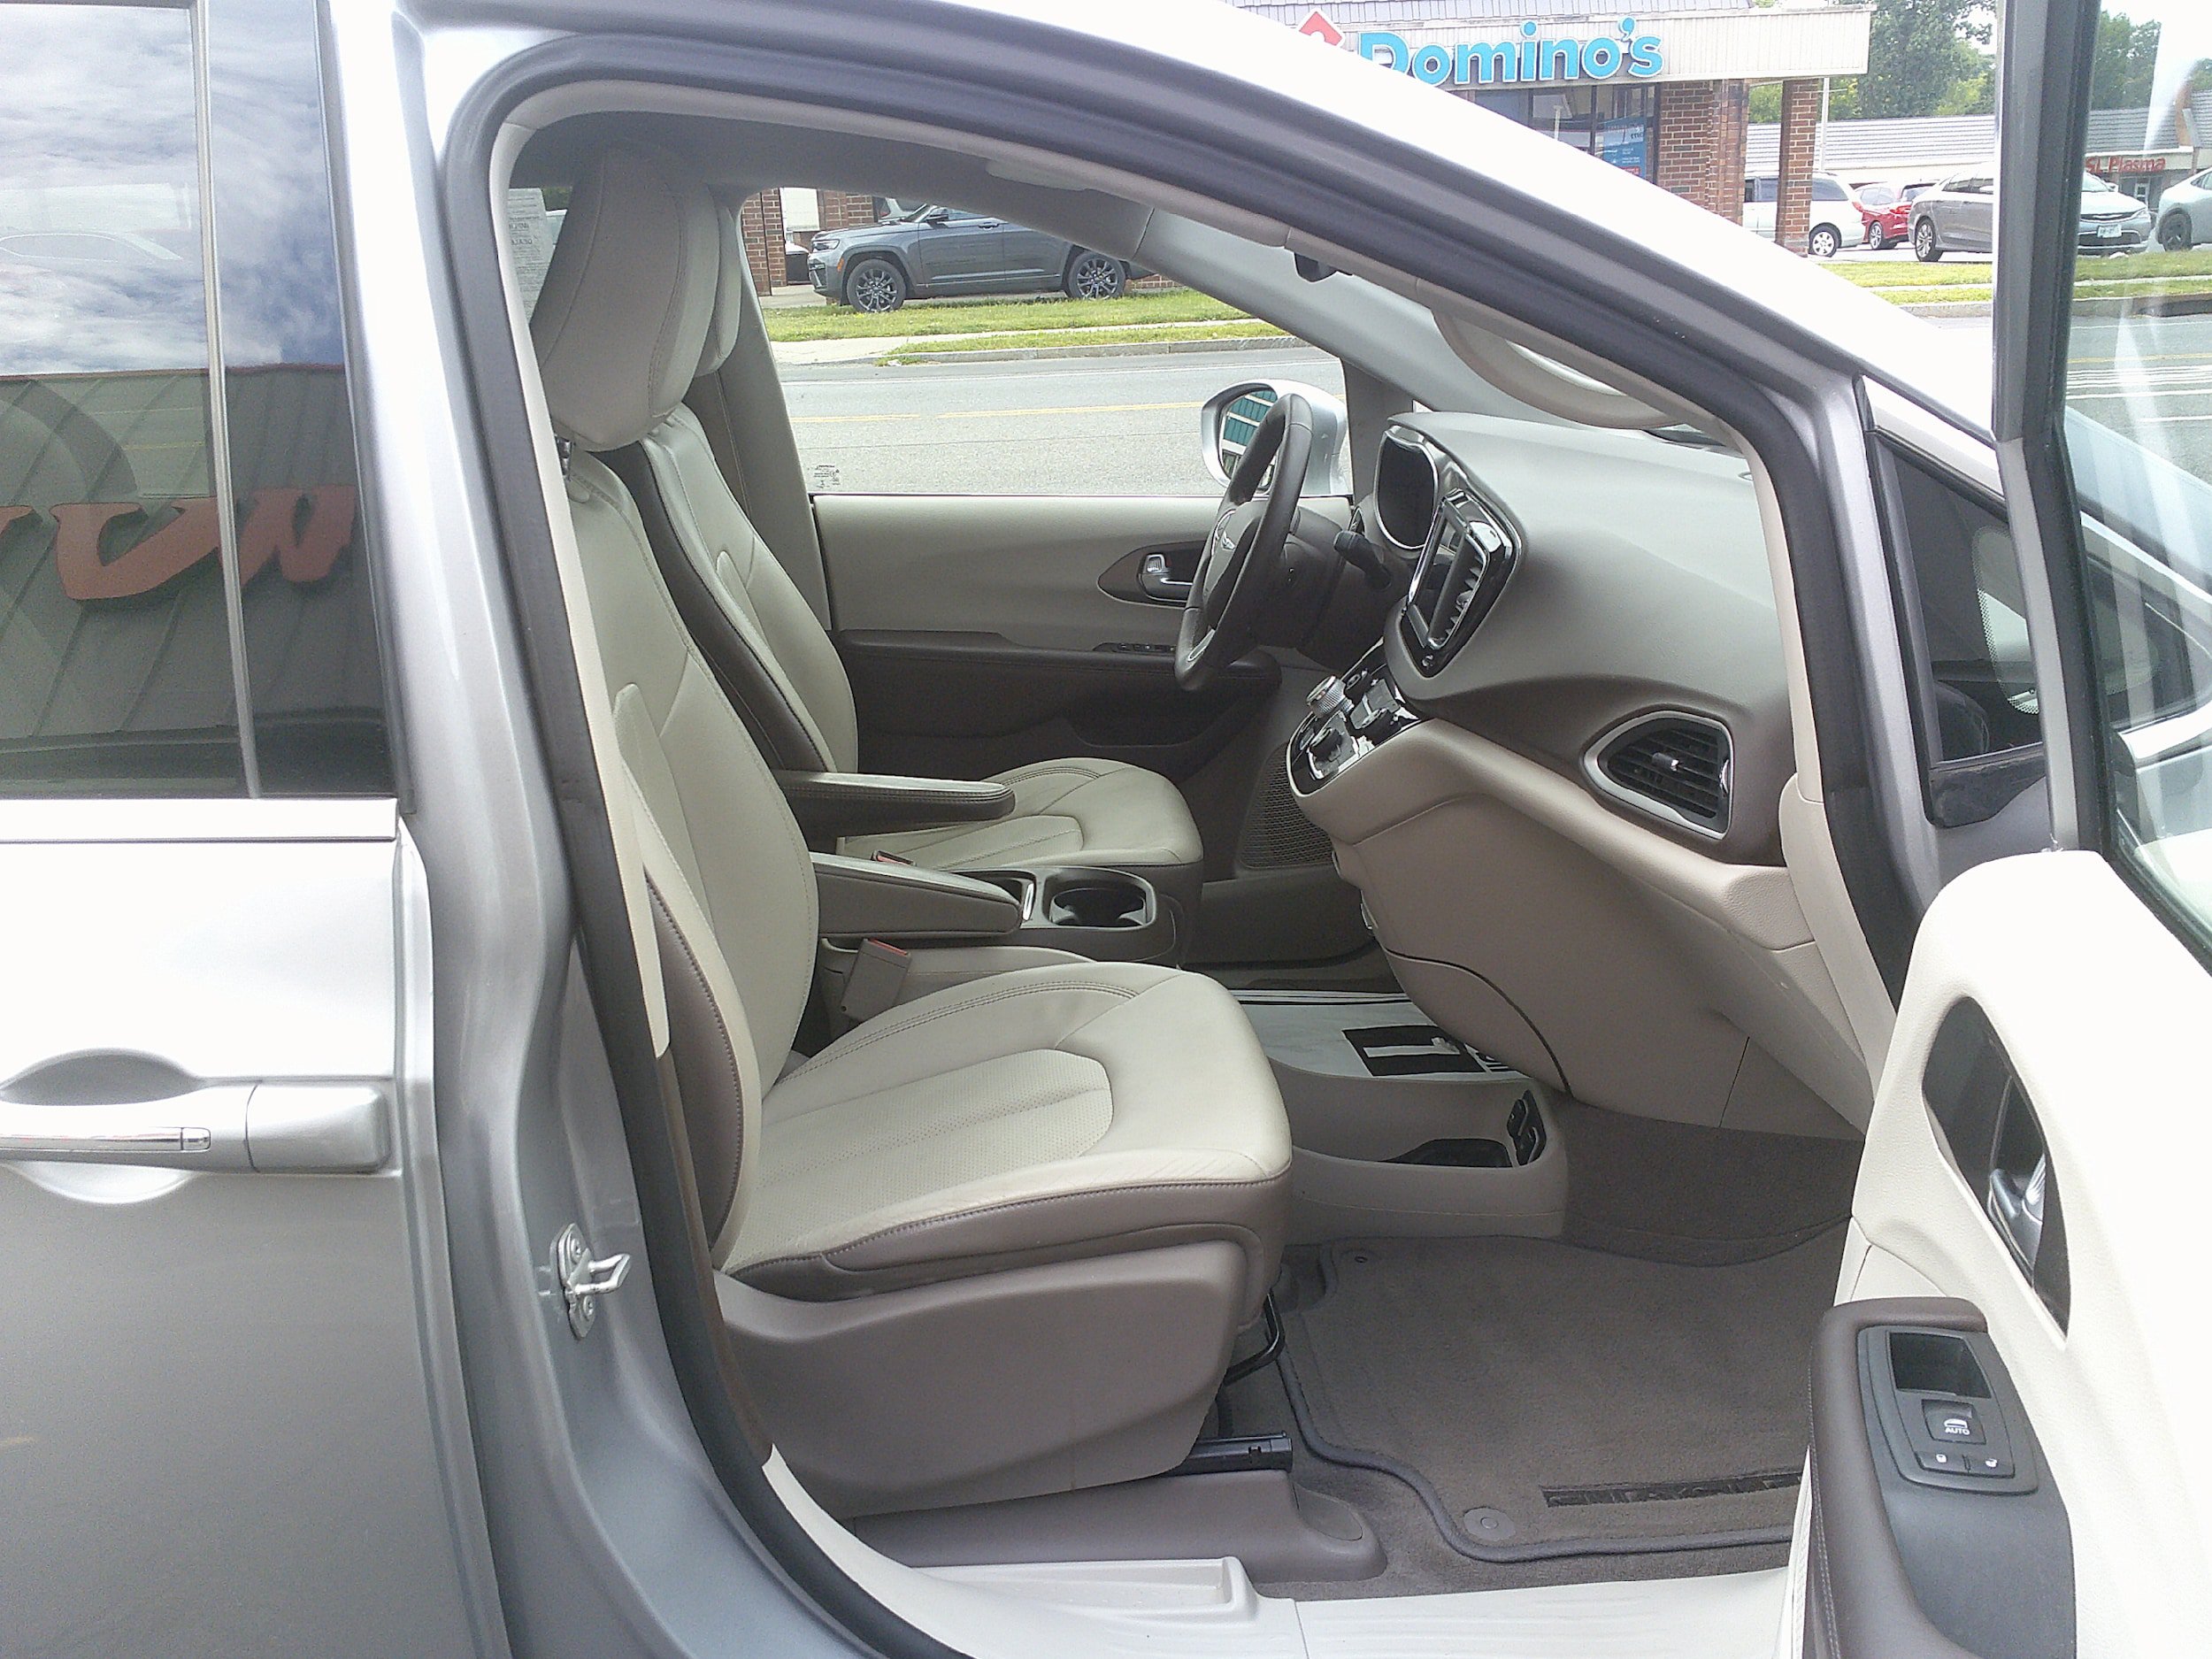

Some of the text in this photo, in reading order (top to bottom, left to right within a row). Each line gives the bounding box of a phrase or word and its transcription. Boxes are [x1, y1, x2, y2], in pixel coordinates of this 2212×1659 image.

[1357, 16, 1666, 86] Domino's
[2108, 156, 2166, 173] Plasma
[1945, 1427, 1970, 1436] AUTO
